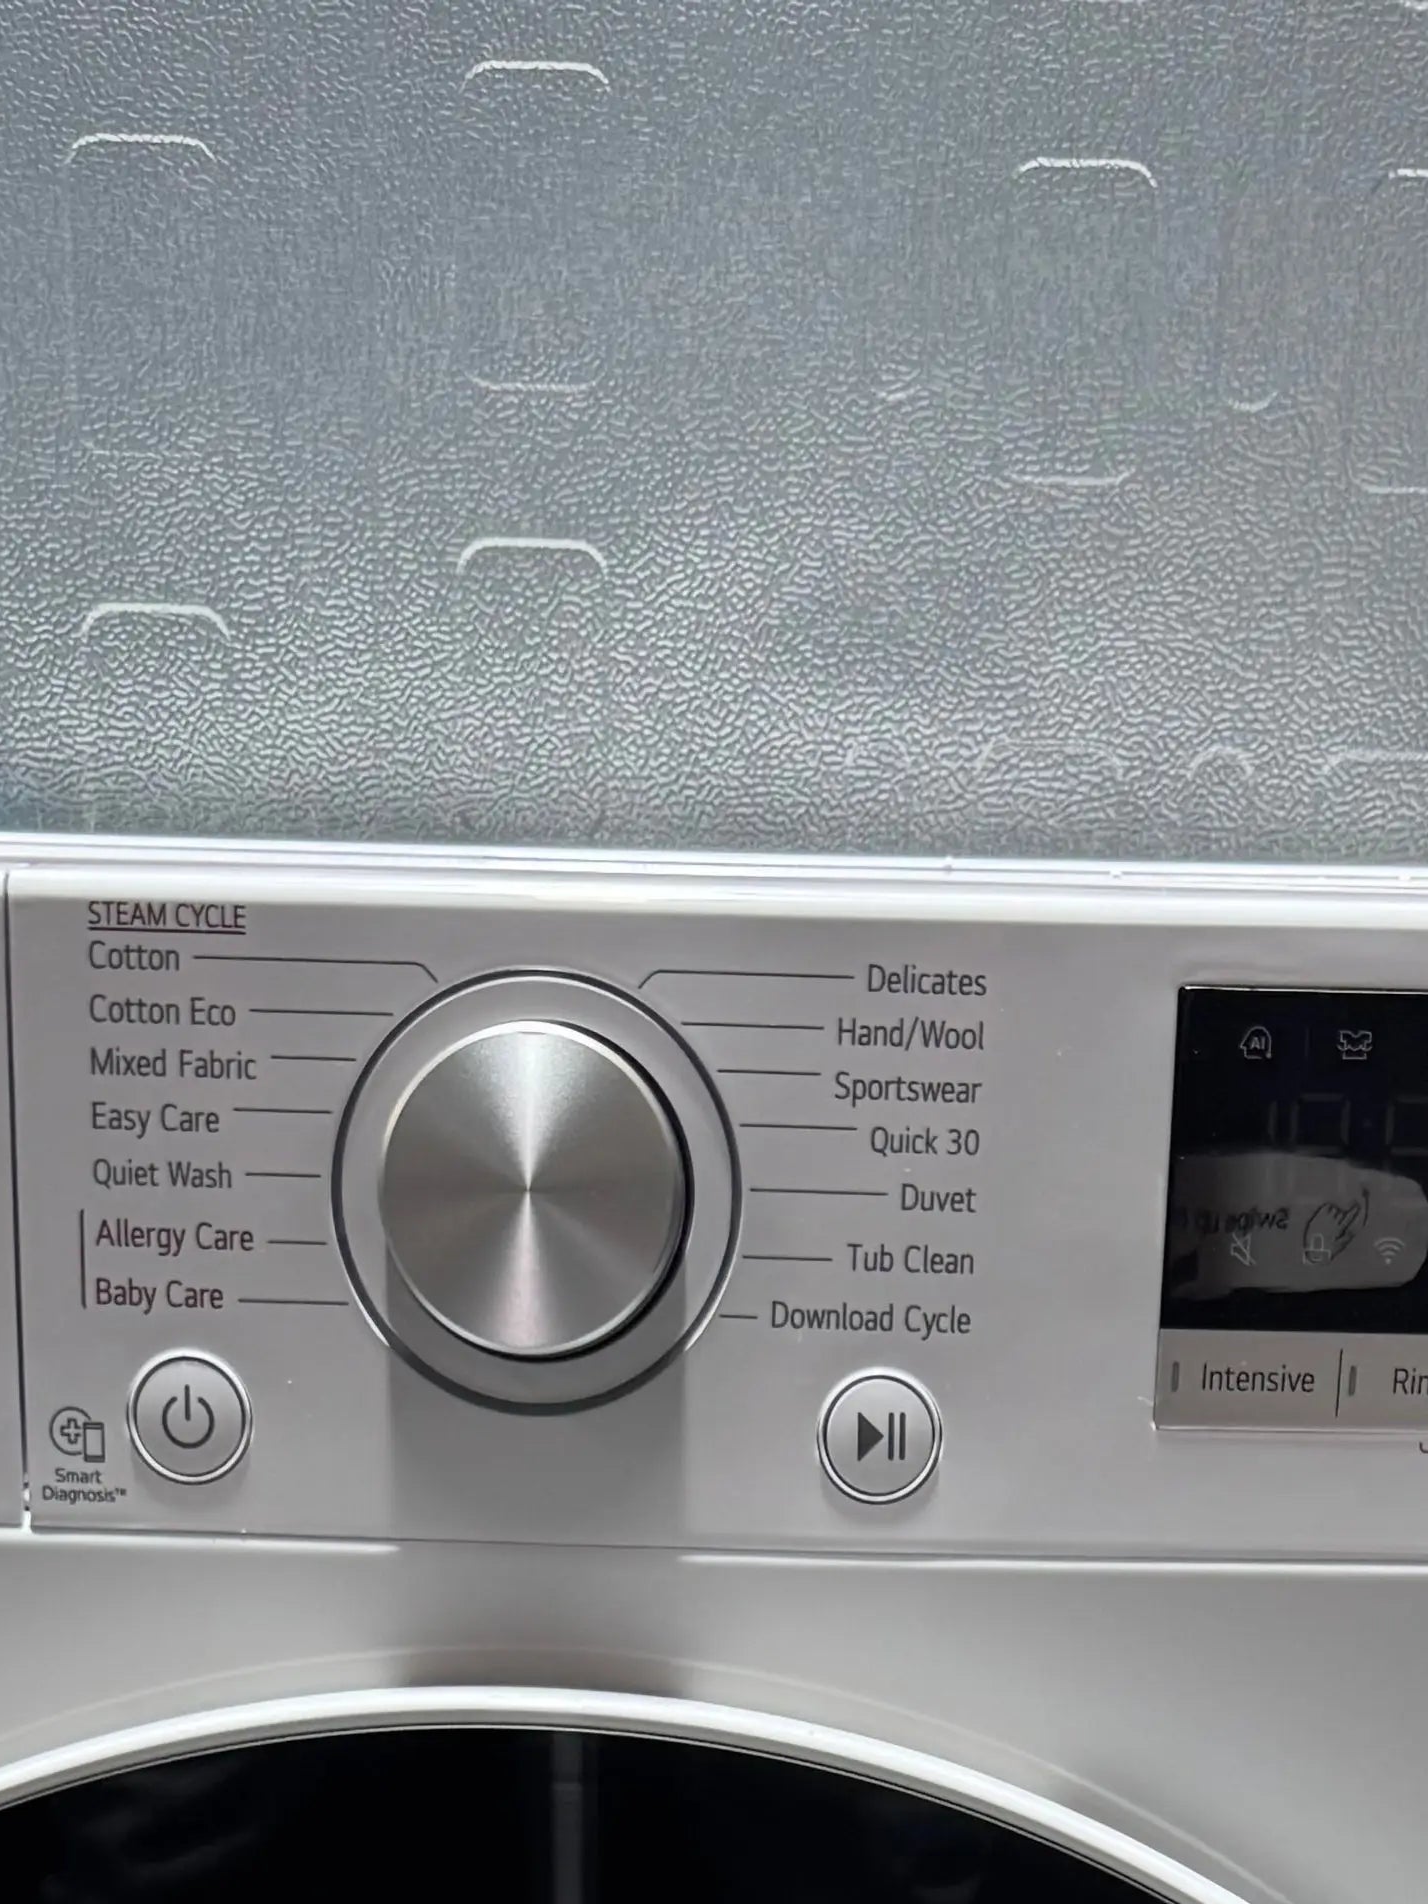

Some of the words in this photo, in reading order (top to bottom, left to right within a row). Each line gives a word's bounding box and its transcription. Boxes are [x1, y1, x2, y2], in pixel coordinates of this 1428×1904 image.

[88, 901, 172, 929] STEAM
[175, 904, 247, 931] CYCLE
[88, 940, 181, 972] Cotton
[866, 963, 988, 998] Delicates
[88, 993, 181, 1025] Cotton
[190, 997, 237, 1027] Eco
[836, 1016, 986, 1052] Hand/Wool
[89, 1046, 167, 1079] Mixed
[178, 1048, 258, 1081] Fabric
[834, 1070, 983, 1108] Sportswear
[91, 1102, 151, 1139] Easy
[160, 1104, 220, 1134] Care
[870, 1125, 939, 1157] Quick
[946, 1128, 981, 1157] 30
[92, 1158, 160, 1190] Quiet
[167, 1160, 233, 1190] Wash
[900, 1183, 977, 1214] Duvet
[95, 1218, 187, 1259] Allergy
[195, 1222, 255, 1253] Care
[847, 1243, 895, 1274] Tub
[904, 1244, 975, 1275] Clean
[95, 1277, 156, 1316] Baby
[165, 1280, 225, 1311] Care
[771, 1300, 894, 1334] Download
[904, 1303, 972, 1342] Cycle
[1201, 1361, 1316, 1393] Intensive
[54, 1467, 102, 1484] Smart
